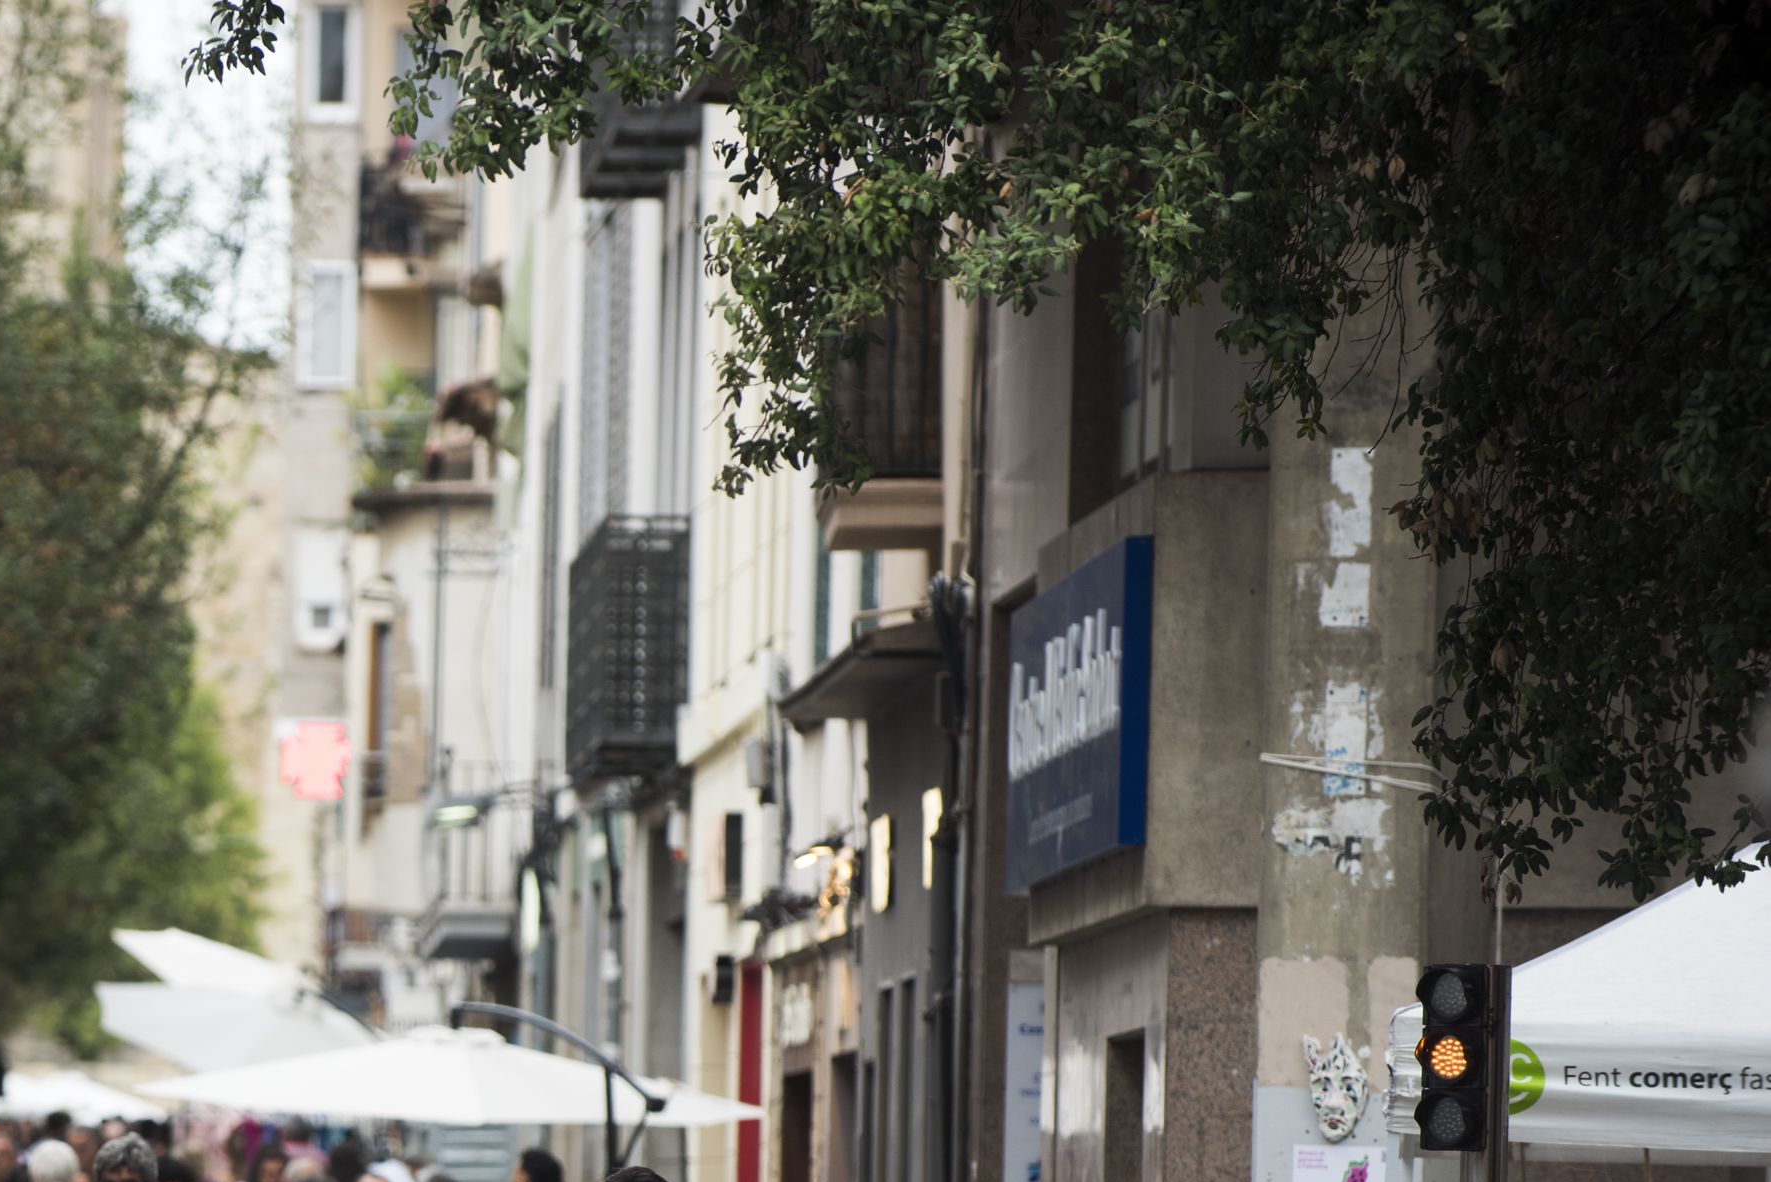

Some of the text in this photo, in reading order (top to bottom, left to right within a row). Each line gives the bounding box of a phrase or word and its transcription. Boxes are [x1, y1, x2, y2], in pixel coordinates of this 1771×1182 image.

[1564, 1065, 1771, 1095] Fent comerç fas
